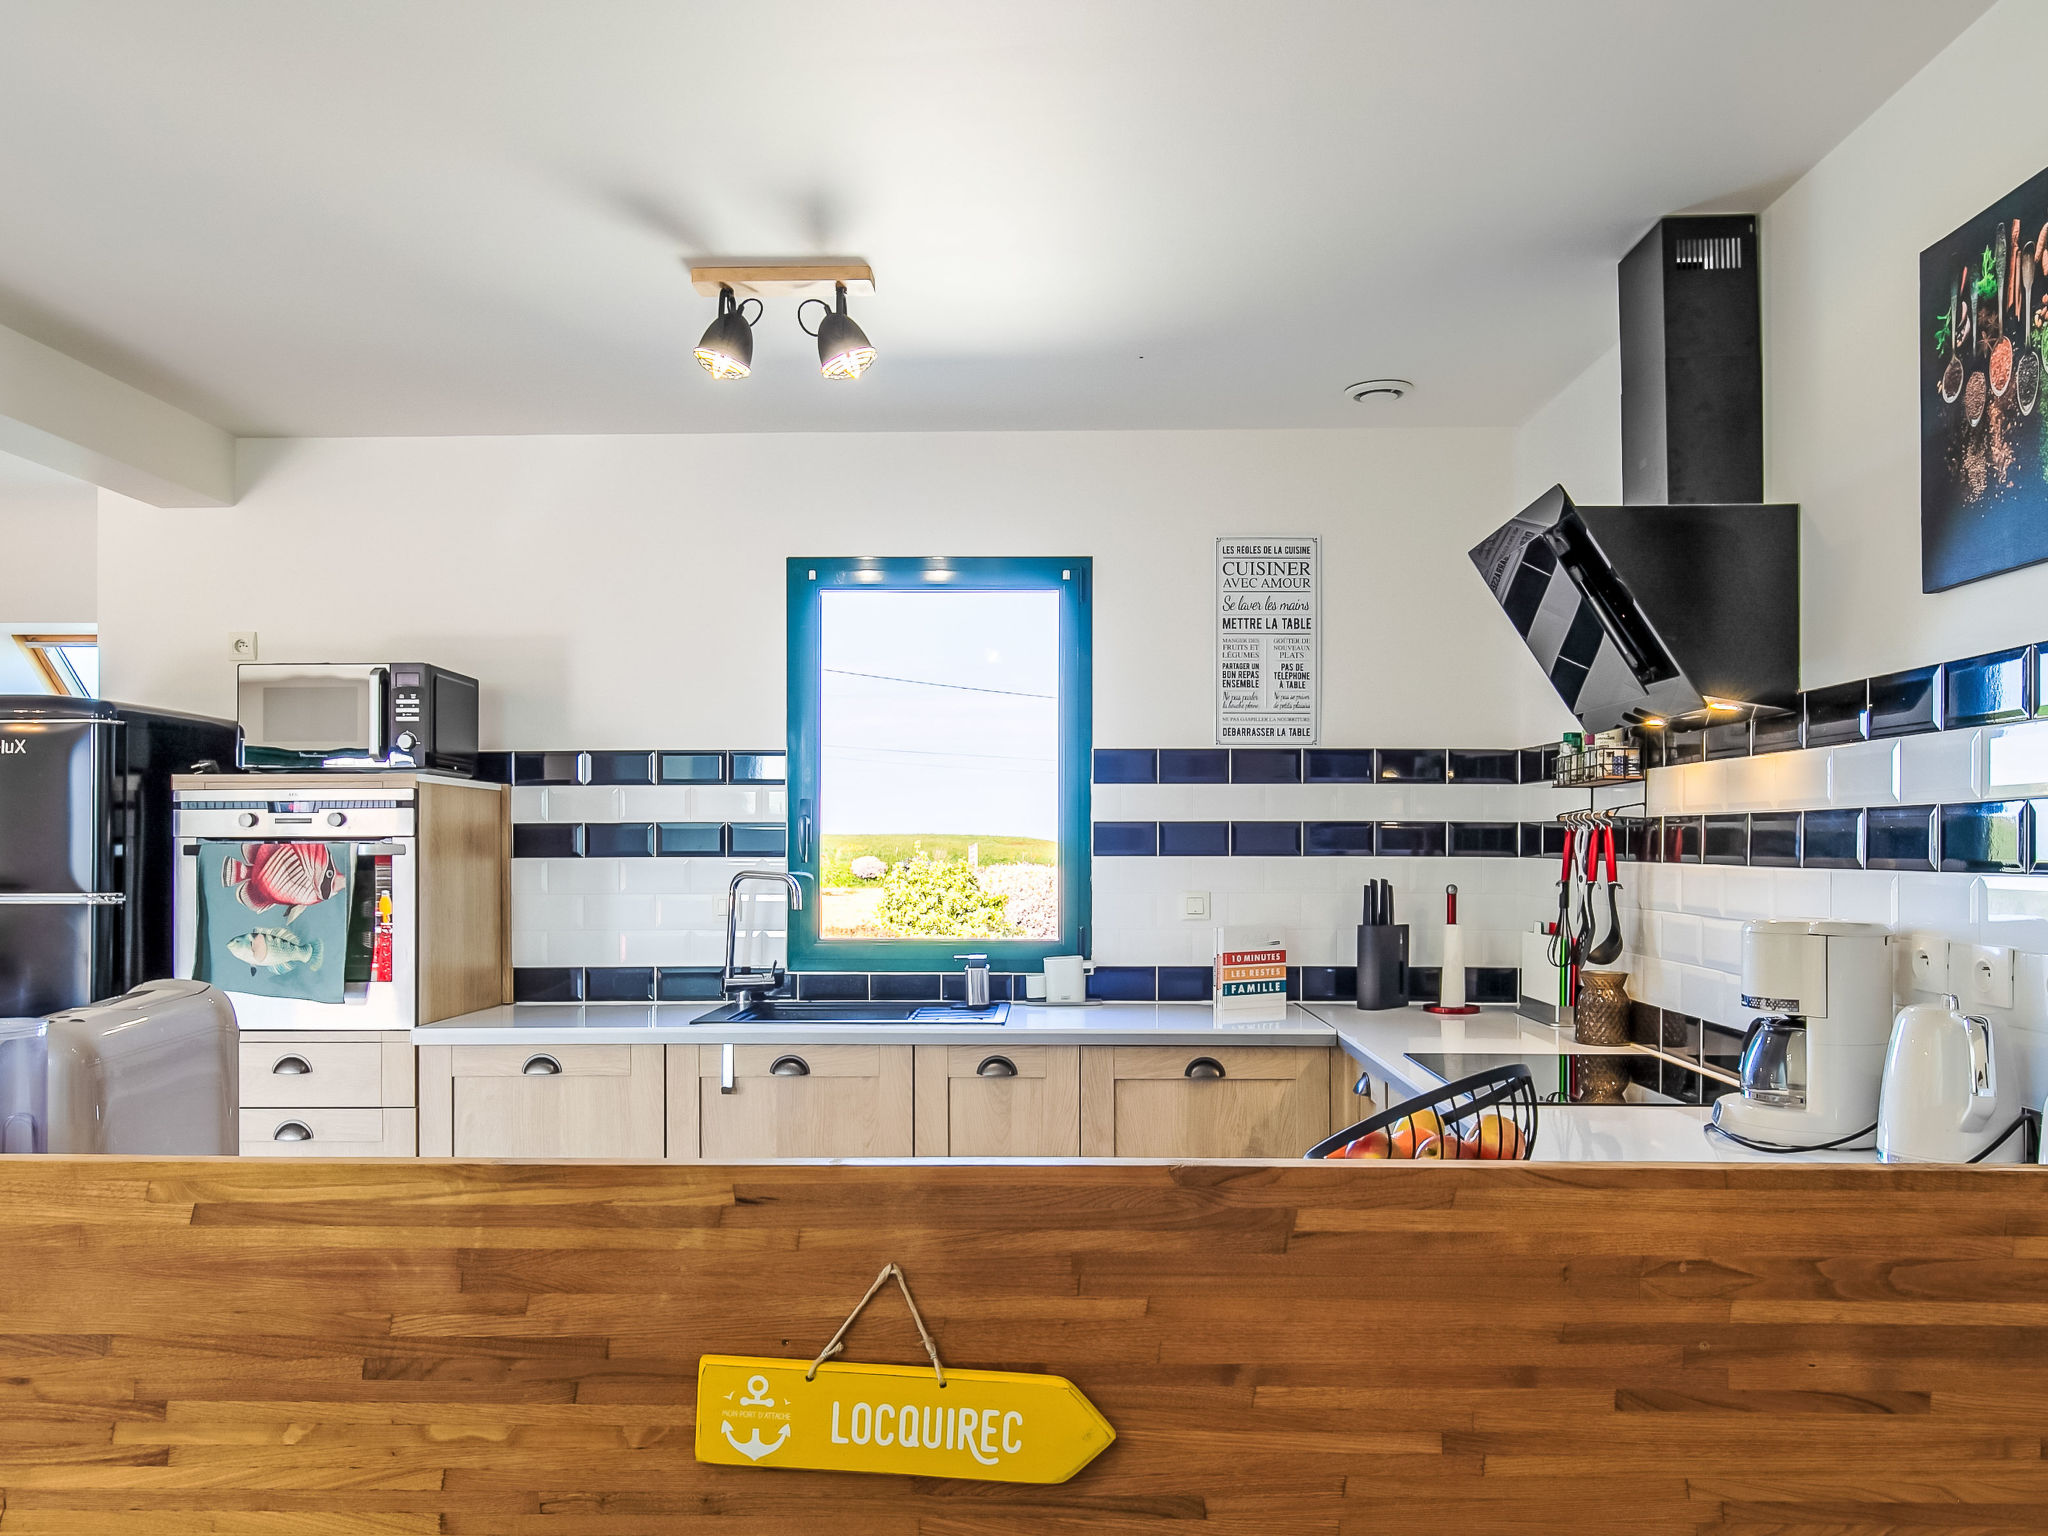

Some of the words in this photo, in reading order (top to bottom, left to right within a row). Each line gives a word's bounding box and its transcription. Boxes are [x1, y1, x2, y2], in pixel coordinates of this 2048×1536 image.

[1222, 546, 1235, 554] LES
[1263, 546, 1272, 554] DE
[1274, 546, 1282, 554] LA
[1284, 546, 1311, 554] CUISINE
[1222, 562, 1311, 576] CUISINER
[1222, 578, 1258, 588] AVEC
[1261, 578, 1311, 588] AMOUR
[1222, 595, 1236, 612] Se
[1237, 595, 1261, 611] laver
[1264, 595, 1277, 611] les
[1279, 599, 1310, 611] mains
[1222, 618, 1262, 630] METTRE
[1265, 618, 1278, 630] LA
[1282, 618, 1312, 630] TABLE
[1222, 650, 1260, 659] LÉGUMES
[1279, 651, 1305, 659] PLATS
[1222, 662, 1250, 670] PARTAGER
[1251, 662, 1260, 670] UN
[1280, 663, 1294, 671] PAS
[1295, 663, 1304, 671] DE
[1222, 670, 1236, 679] BON
[1237, 670, 1260, 679] REPAS
[1222, 679, 1260, 688] ENSEMBLE
[1286, 681, 1306, 689] TABLE
[1277, 728, 1286, 737] LA
[1289, 728, 1311, 737] TABLE
[1, 738, 27, 754] luX
[1232, 955, 1242, 963] 10
[1243, 953, 1281, 962] MINUTES
[1231, 969, 1246, 978] LES
[1249, 967, 1281, 976] RESTES
[1231, 982, 1281, 994] FAMILLE
[831, 1401, 1023, 1466] LOCQUIREC
